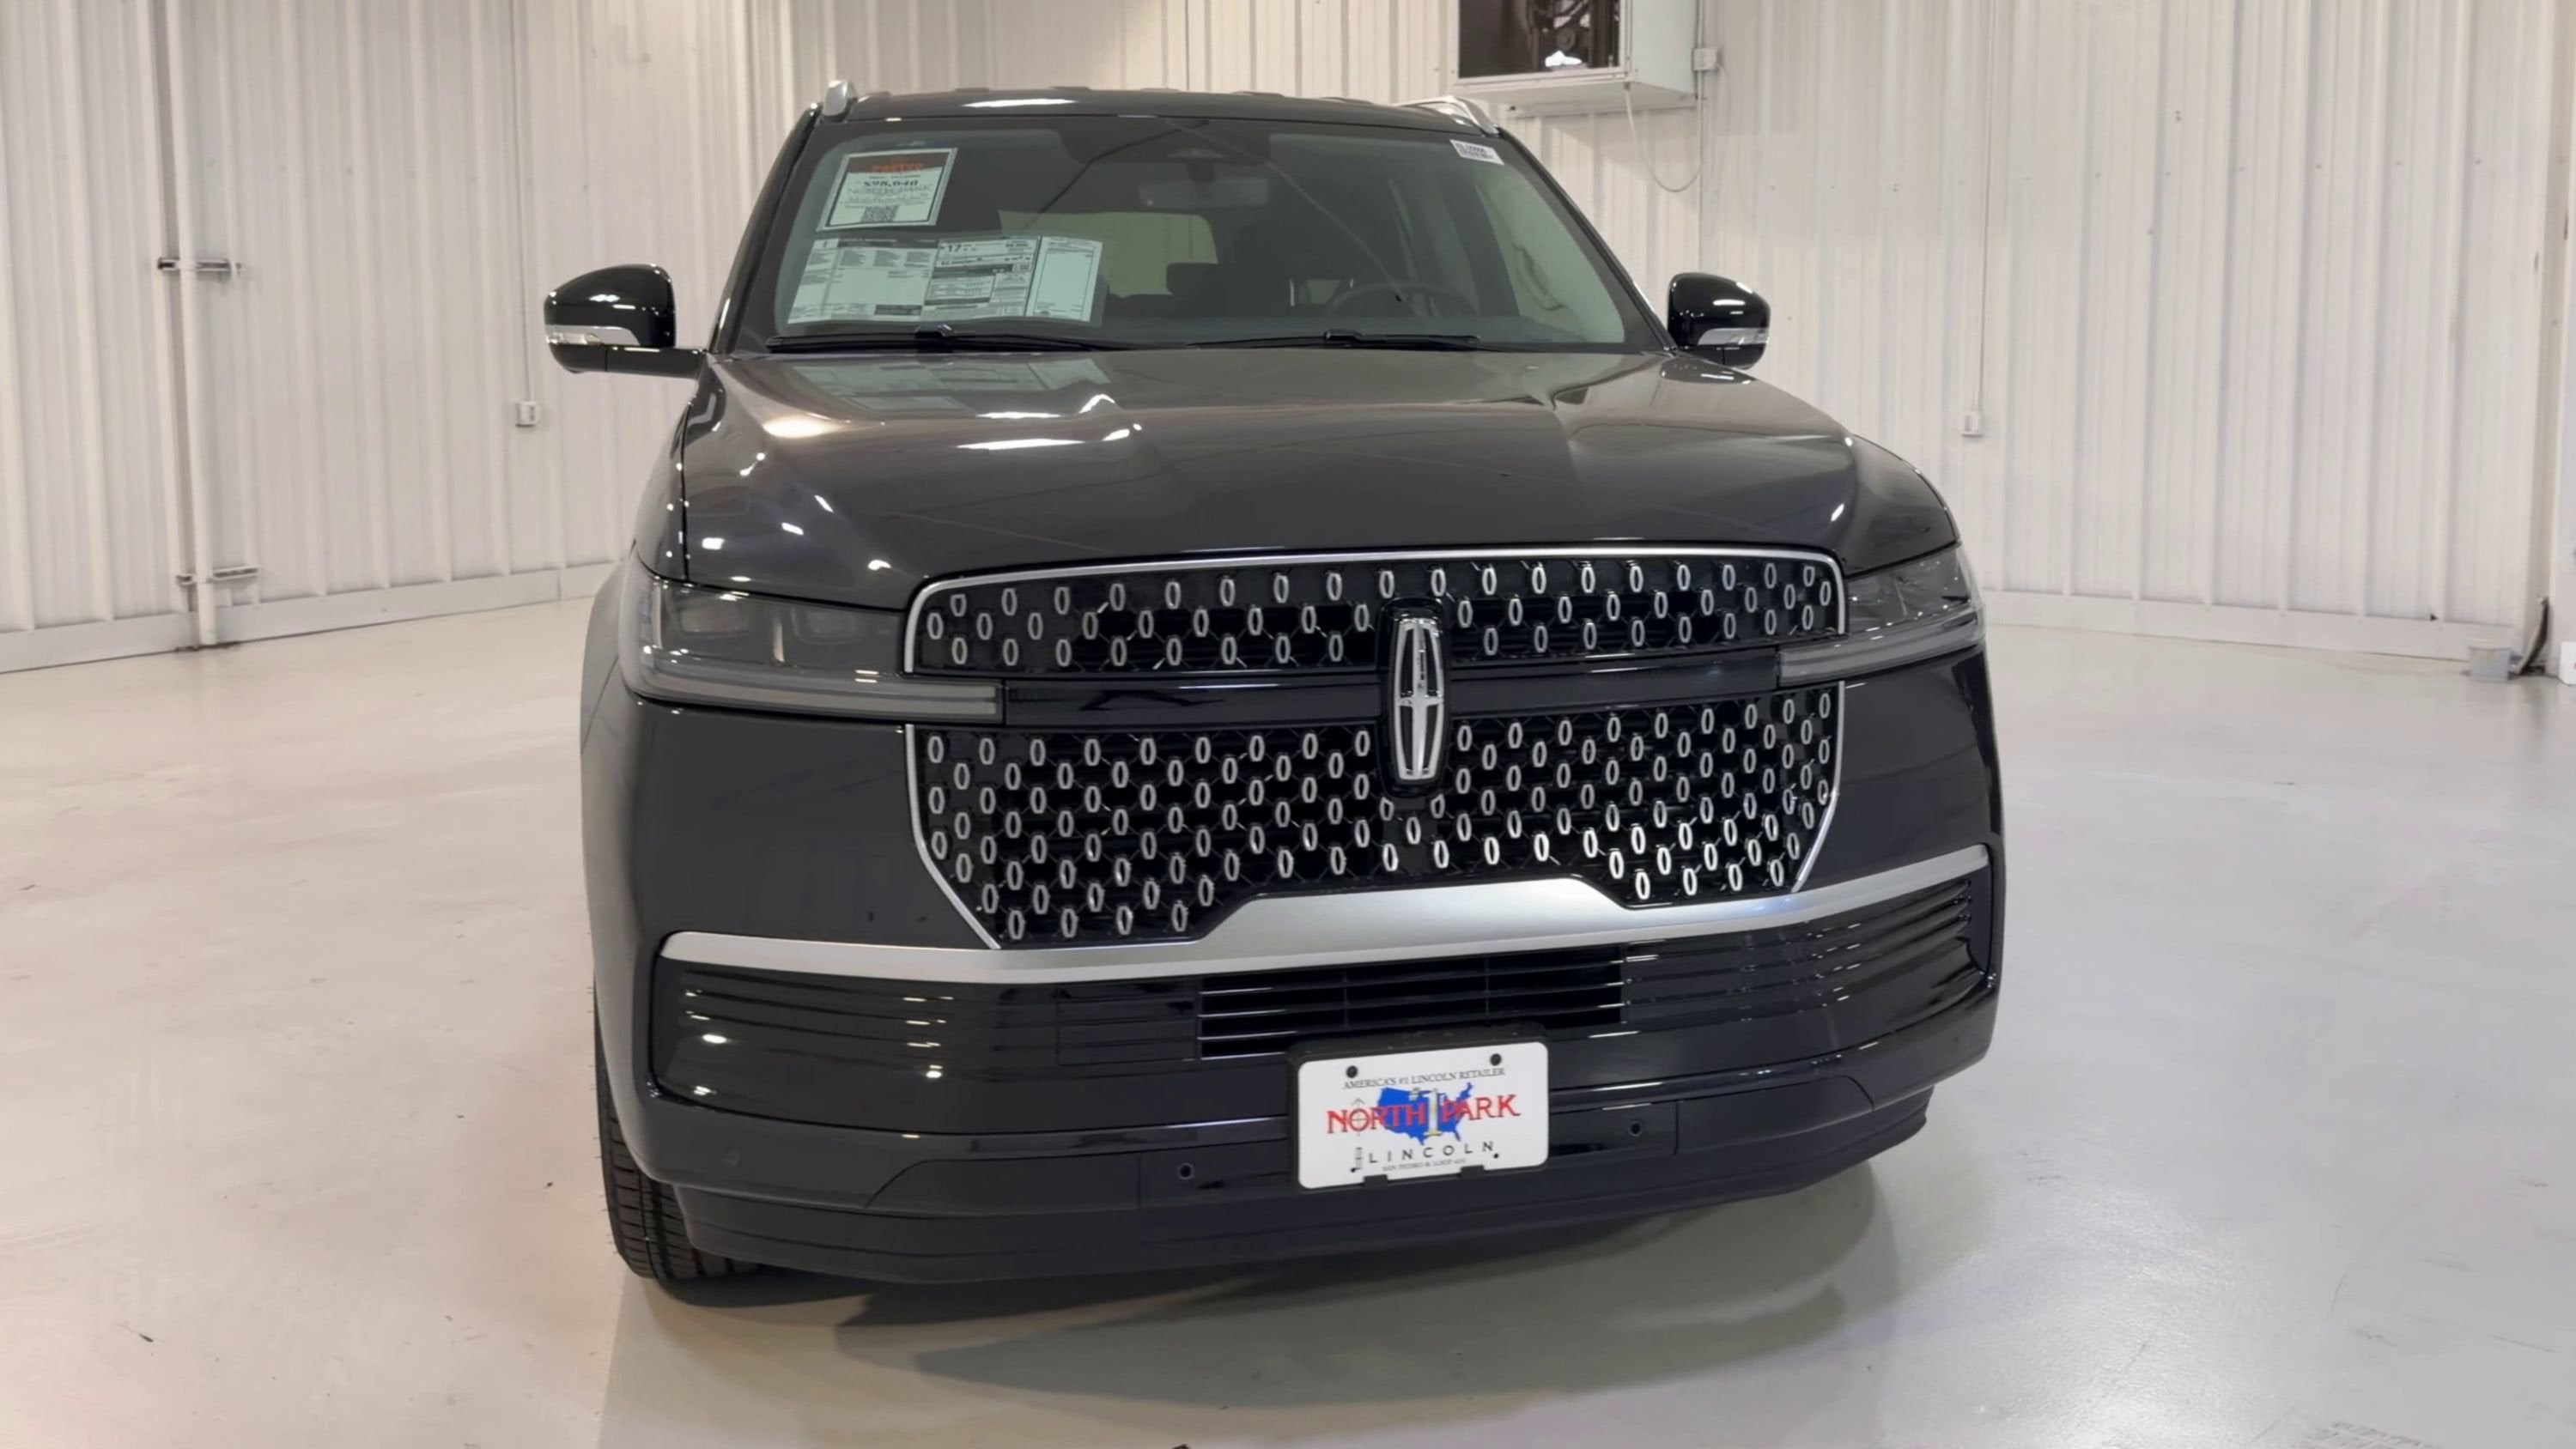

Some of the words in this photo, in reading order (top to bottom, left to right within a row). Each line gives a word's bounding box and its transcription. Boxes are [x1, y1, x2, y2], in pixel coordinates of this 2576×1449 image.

[1411, 1071, 1457, 1084] LINCOLN
[1459, 1067, 1505, 1080] RETAILER
[1326, 1102, 1426, 1135] NORTH
[1441, 1094, 1521, 1123] PARK
[1369, 1140, 1494, 1164] LINCOLN
